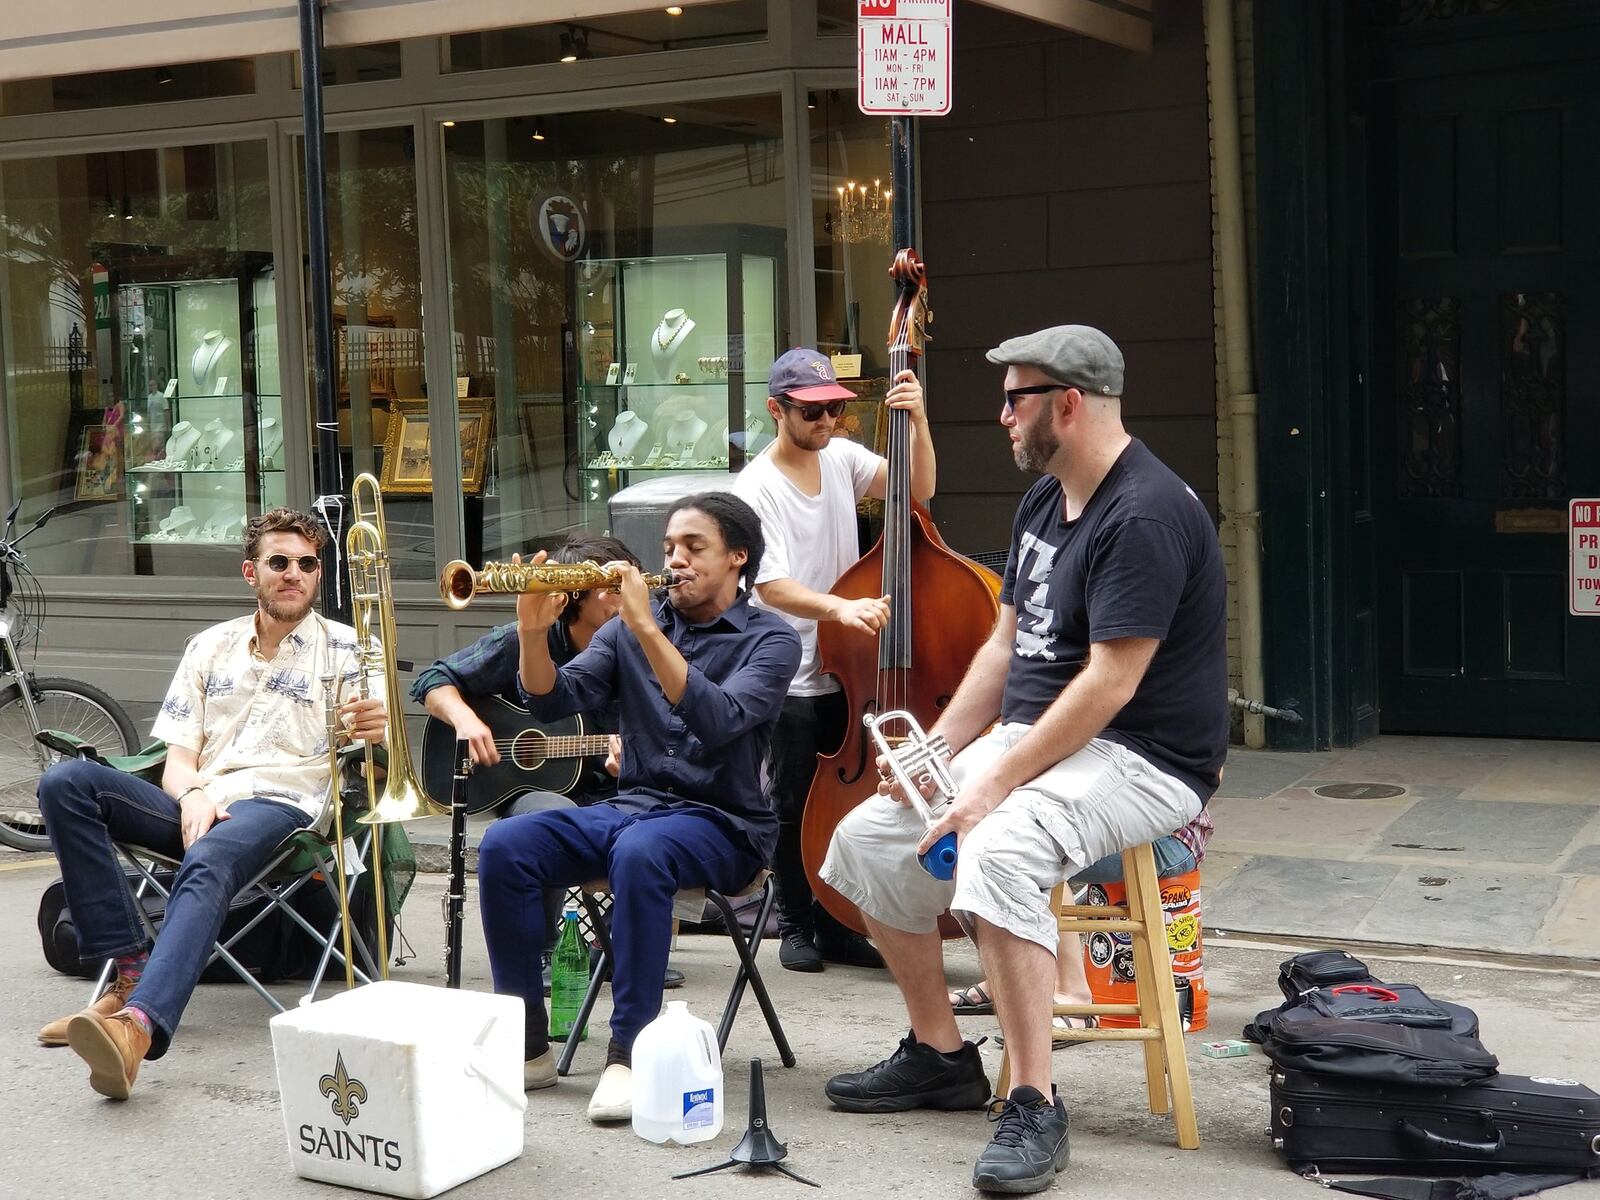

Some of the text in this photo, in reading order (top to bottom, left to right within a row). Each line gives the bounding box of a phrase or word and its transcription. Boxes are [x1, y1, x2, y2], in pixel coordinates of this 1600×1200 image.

[881, 23, 928, 45] MALL
[875, 48, 898, 62] 11AM
[913, 48, 936, 62] 4PM
[886, 63, 902, 73] MON
[912, 63, 924, 73] FRI
[875, 77, 898, 91] 11AM
[913, 77, 936, 91] 7PM
[886, 92, 900, 102] SAT
[909, 92, 925, 102] SUN
[1575, 505, 1591, 523] NO
[1579, 534, 1598, 549] PR
[1588, 554, 1600, 570] D
[299, 1124, 402, 1172] SAINTS
